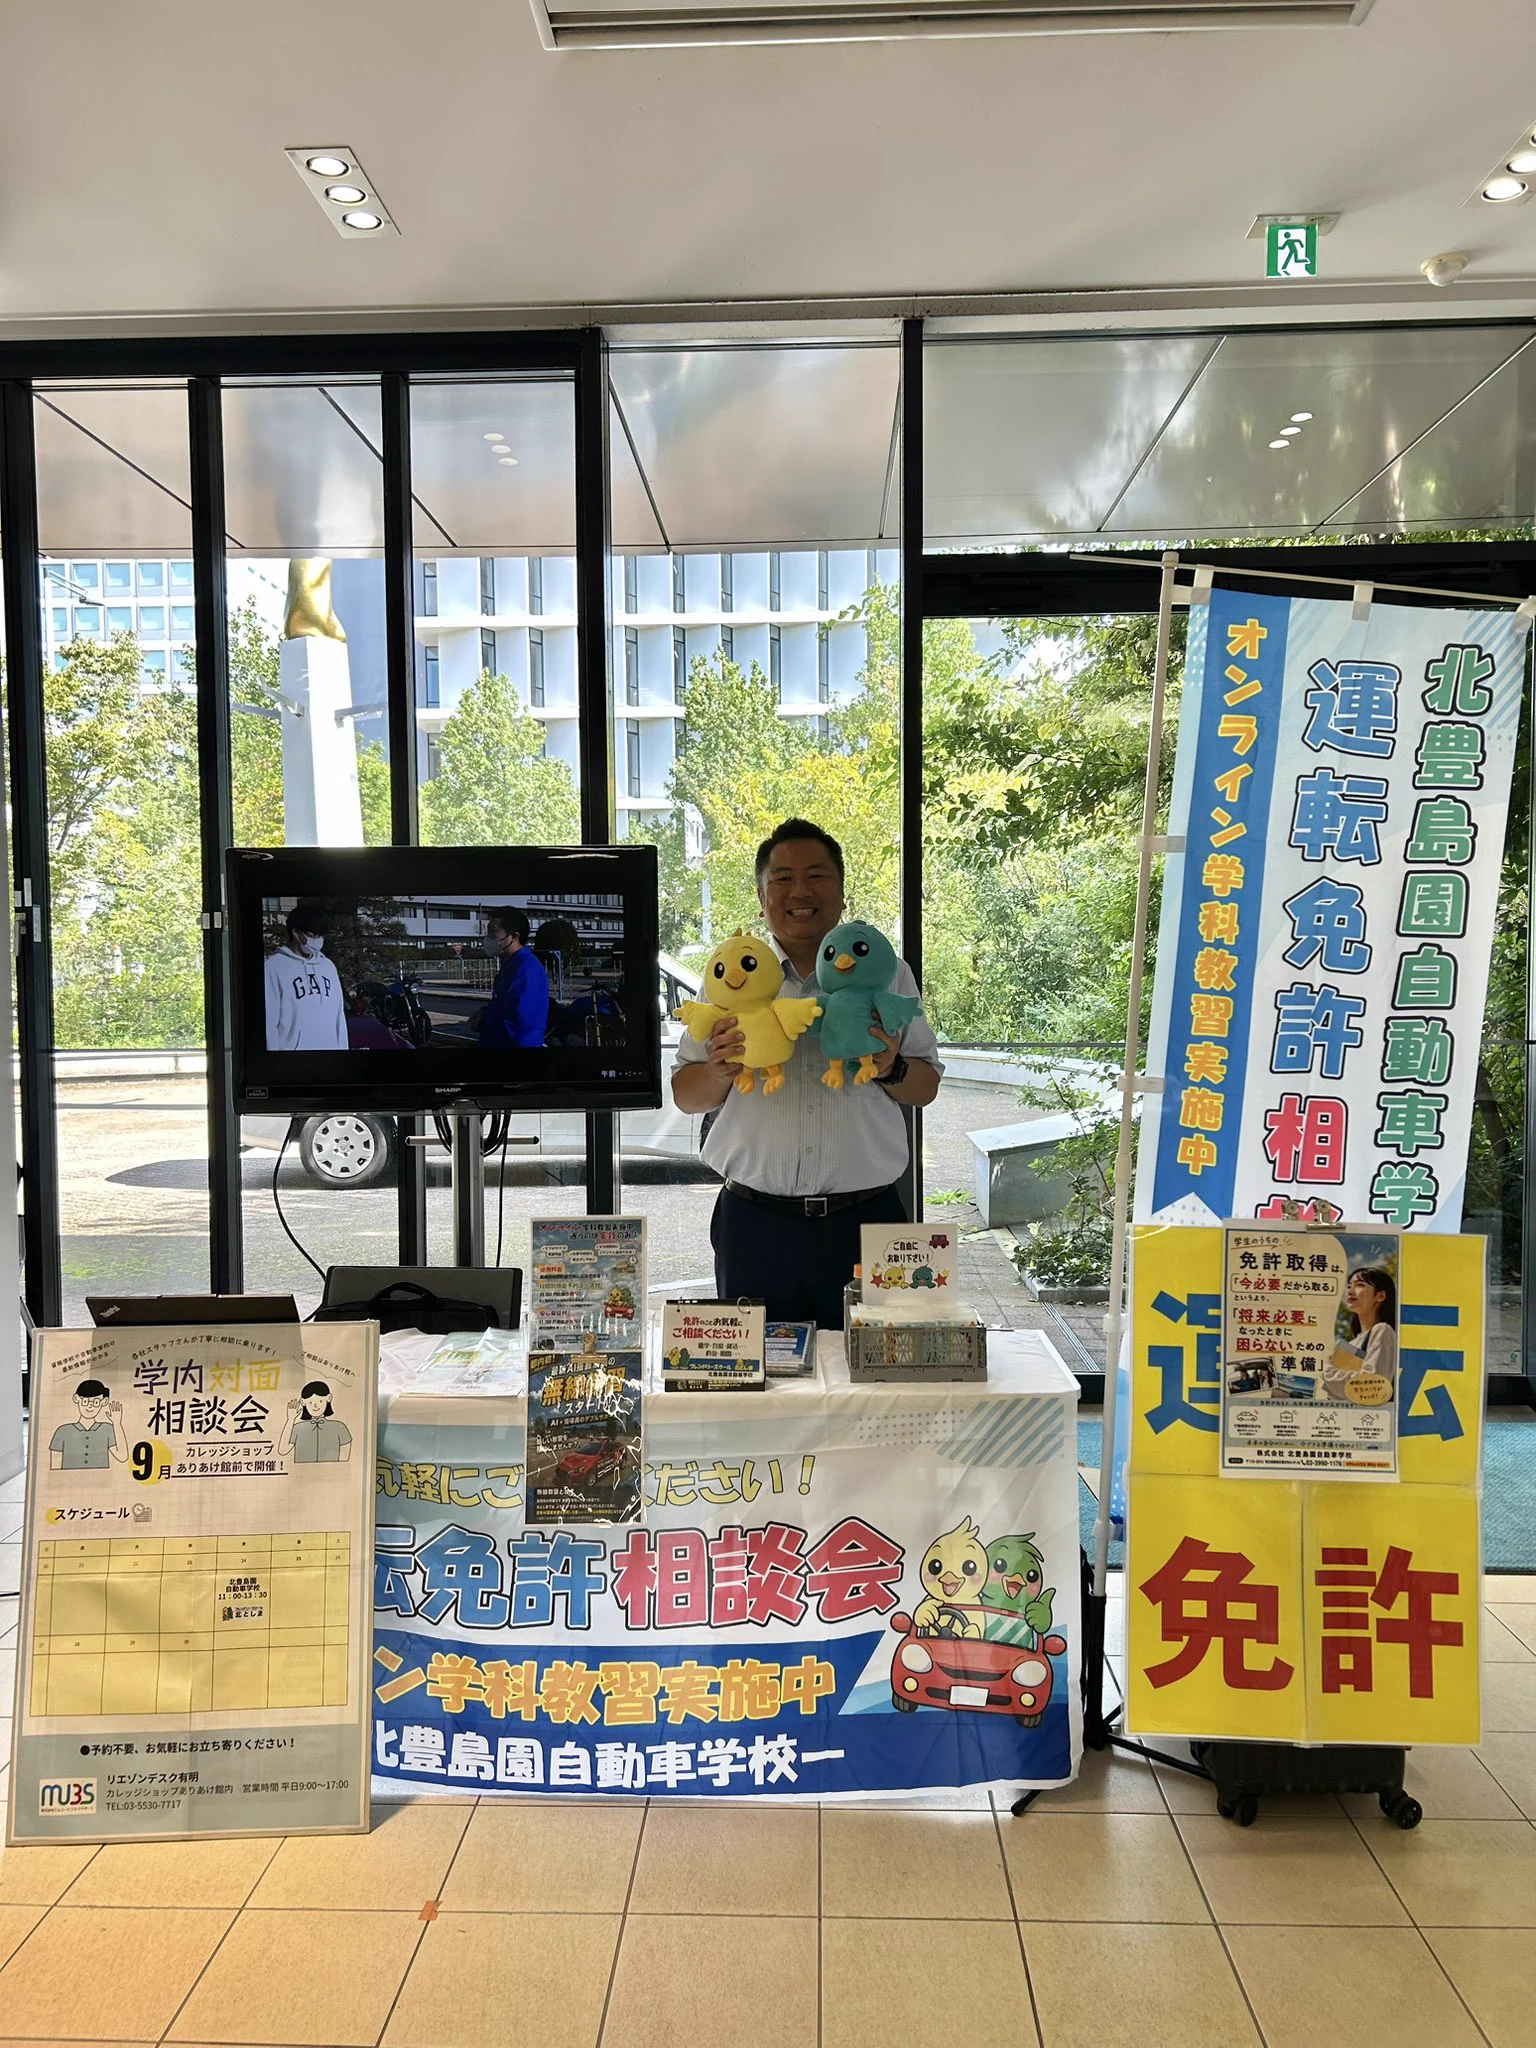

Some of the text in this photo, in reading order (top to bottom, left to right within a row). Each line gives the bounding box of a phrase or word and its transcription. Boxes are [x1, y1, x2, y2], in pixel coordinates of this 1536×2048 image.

[1176, 618, 1268, 1177] オンライン学科教習実施中
[293, 973, 331, 1000] GAP
[893, 1241, 919, 1251] ご自由に
[1233, 1236, 1280, 1247] 学生のうちの
[887, 1253, 930, 1264] お取り下さい！
[1239, 1251, 1344, 1274] 免許取得は、
[1233, 1277, 1335, 1293] 「今必要だから取る」
[1233, 1293, 1271, 1303] というより、
[683, 1316, 743, 1327] 免許のことお気軽に
[1233, 1307, 1317, 1325] 「将来必要に
[672, 1328, 750, 1339] ご相談ください！
[1238, 1326, 1293, 1337] なったときに
[1236, 1337, 1326, 1352] 困らないための
[1281, 1355, 1325, 1372] 準備」
[132, 1358, 281, 1395] 学内対面
[147, 1394, 270, 1436] 相談会
[185, 1444, 275, 1458] カレッジショップ
[131, 1441, 172, 1482] 9月
[176, 1460, 285, 1474] ありあけ館前で開催！
[54, 1506, 130, 1521] スケジュール
[225, 1584, 260, 1593] 自動車学校
[1138, 1535, 1464, 1699] 免許
[374, 1645, 837, 1726] ン学科教習実施中
[106, 1771, 199, 1785] リエゾンデスク有明
[106, 1784, 233, 1798] カレッジショップありあけ館内
[242, 1782, 279, 1793] 営業時間
[106, 1799, 182, 1812] TEL:03-5530-7717
